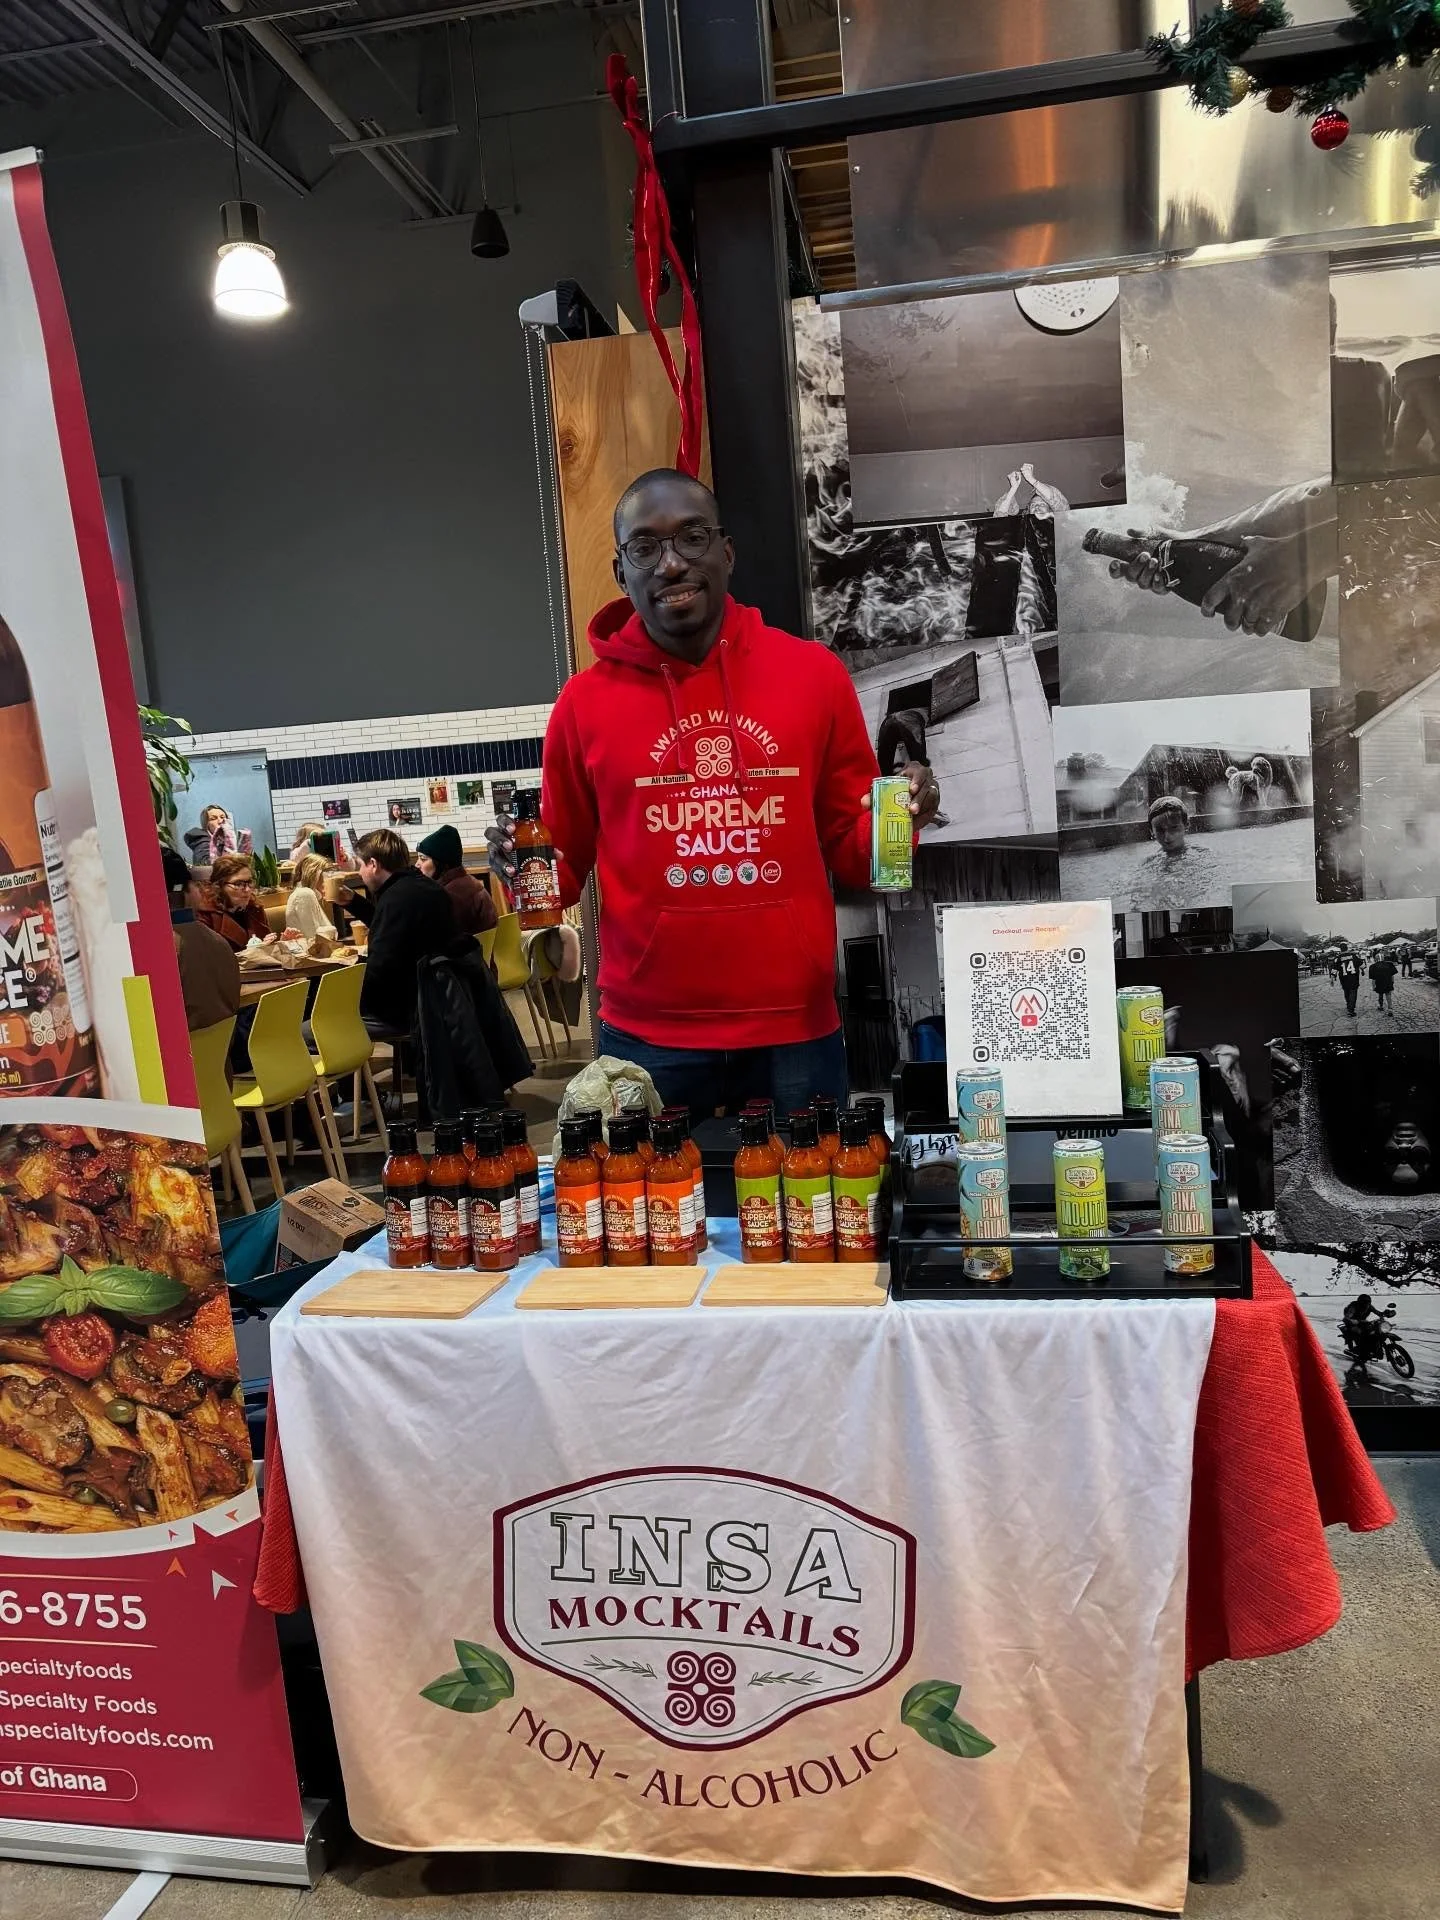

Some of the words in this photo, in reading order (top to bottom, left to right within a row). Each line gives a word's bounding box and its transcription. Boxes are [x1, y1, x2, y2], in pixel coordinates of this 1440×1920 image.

[649, 712, 703, 764] AWARD
[708, 709, 779, 757] WINNING
[651, 776, 661, 785] All
[663, 774, 688, 783] Natural
[765, 768, 780, 776] Free
[690, 783, 739, 799] GHANA
[645, 795, 786, 833] SUPREME
[13, 871, 38, 886] Gourmet
[520, 877, 553, 887] SUPREME
[527, 884, 548, 892] SAUCE
[1340, 960, 1357, 976] 14
[978, 1117, 1001, 1138] PINA
[1158, 1109, 1181, 1129] PINA
[1171, 1191, 1197, 1211] PINA
[741, 1211, 776, 1221] SUPREME
[1061, 1199, 1105, 1227] MOJITO
[1167, 1212, 1205, 1233] COLADA
[747, 1220, 770, 1228] SAUCE
[550, 1511, 862, 1604] INSA
[548, 1595, 861, 1658] MOCKTAILS
[95, 1695, 158, 1715] Foods
[506, 1705, 606, 1780] NON
[640, 1729, 899, 1808] ALCOHOLIC
[1, 1766, 23, 1787] of
[30, 1766, 107, 1792] Ghana
